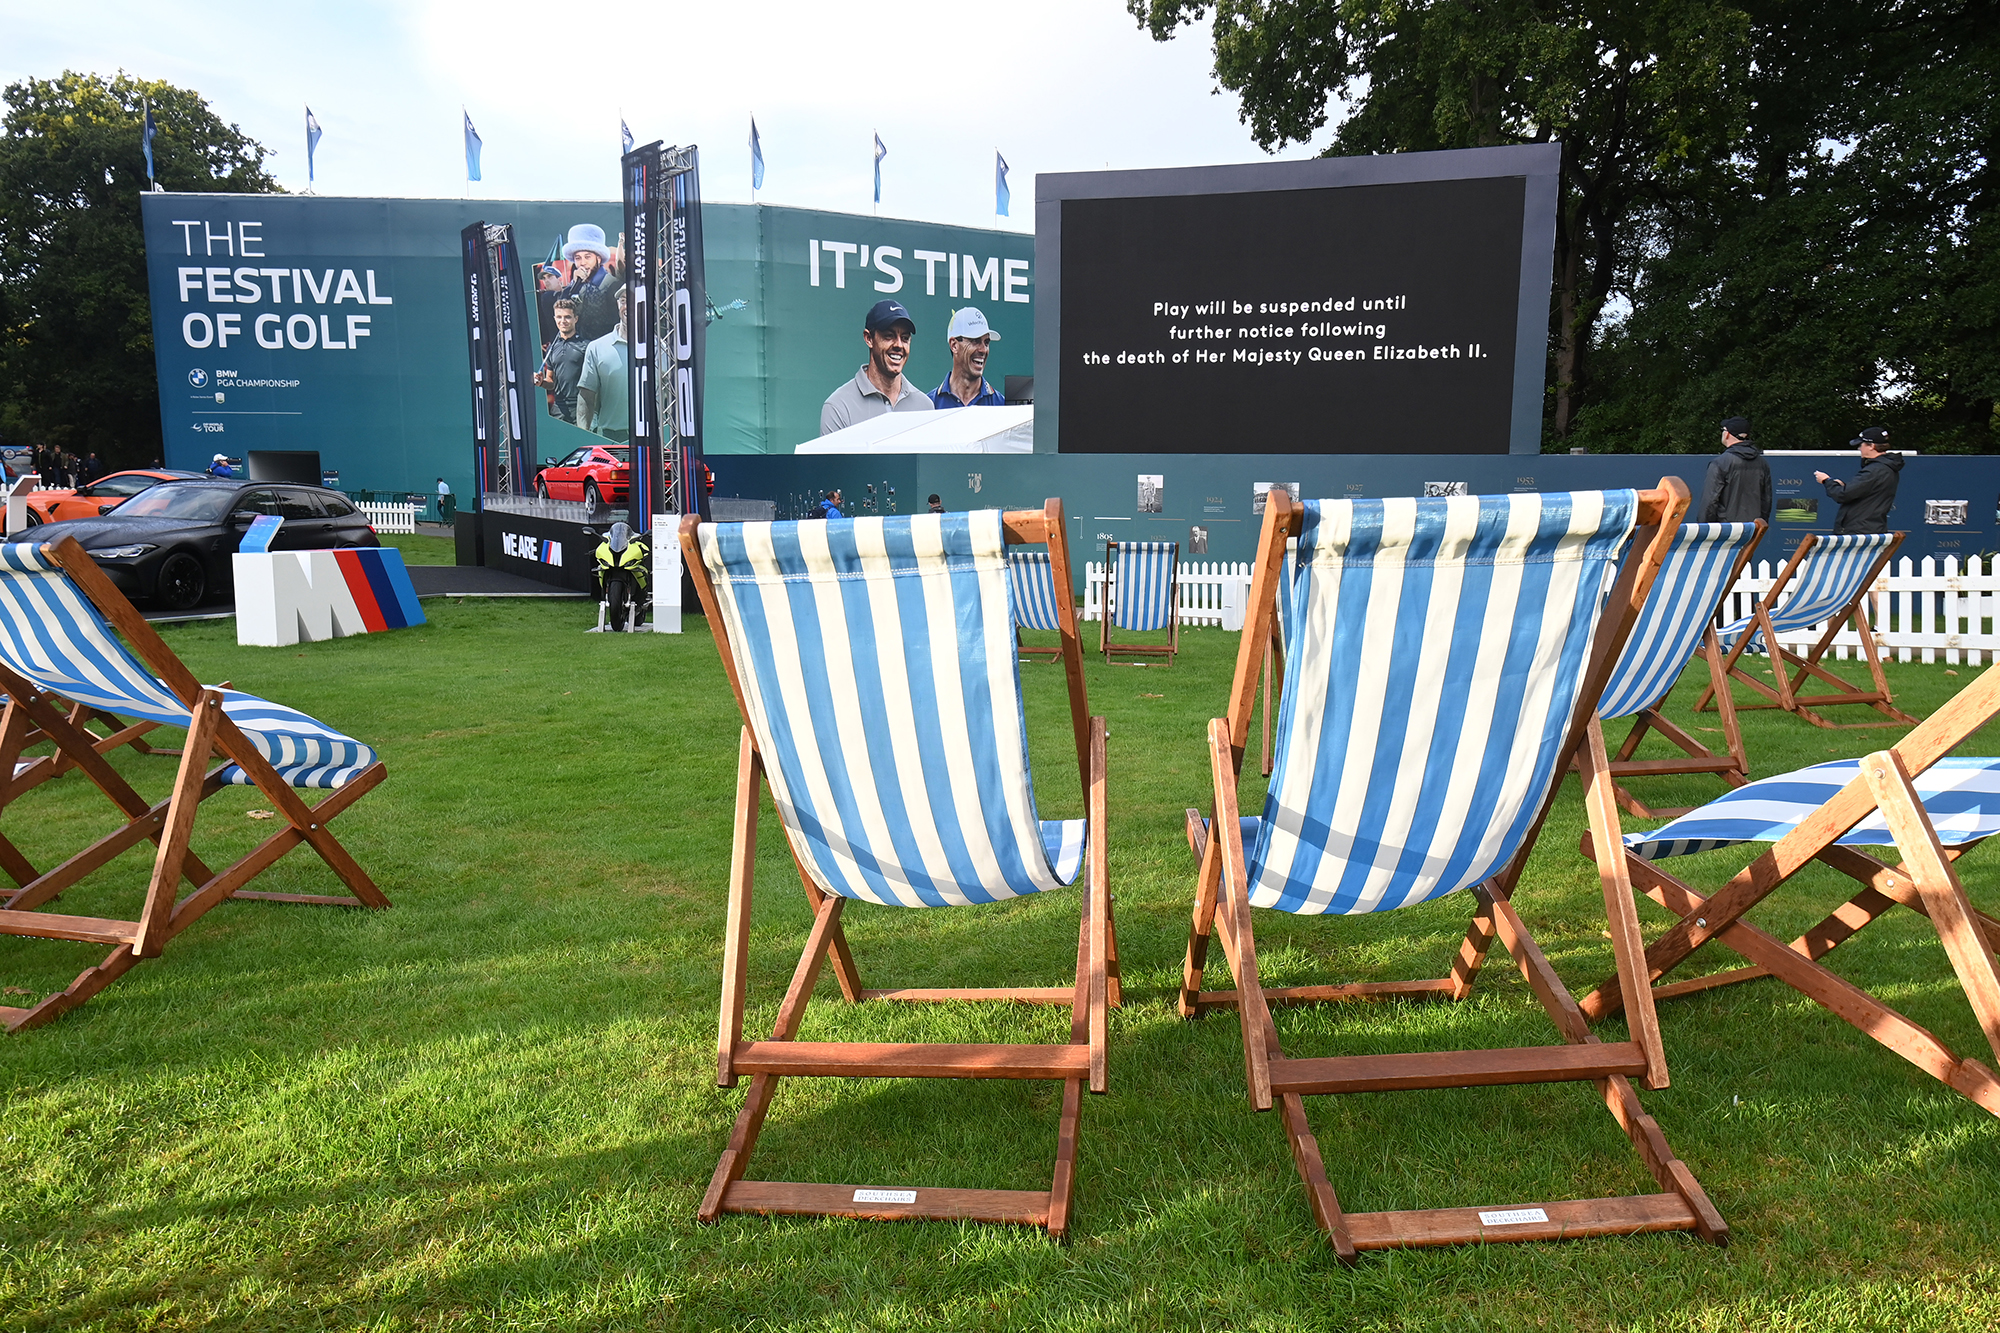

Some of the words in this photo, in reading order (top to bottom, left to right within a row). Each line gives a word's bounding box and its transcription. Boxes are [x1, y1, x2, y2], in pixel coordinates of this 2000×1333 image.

[172, 220, 266, 257] THE
[809, 239, 904, 294] IT'S
[913, 249, 1030, 303] TIME
[177, 266, 393, 305] FESTIVAL
[1153, 302, 1190, 319] Play
[1195, 300, 1226, 315] will
[1232, 299, 1253, 314] be
[1259, 297, 1355, 317] suspended
[1362, 295, 1406, 311] until
[182, 312, 242, 349] OF
[254, 313, 372, 350] GOLF
[1169, 325, 1232, 340] further
[1238, 324, 1294, 338] notice
[1300, 321, 1386, 339] following
[1083, 351, 1111, 365] the
[1116, 350, 1165, 364] death
[1171, 349, 1190, 363] of
[1196, 349, 1226, 363] Her
[1232, 348, 1302, 366] Majesty
[1308, 346, 1366, 362] Queen
[1373, 344, 1461, 360] Elizabeth
[216, 370, 238, 378] BMW
[217, 379, 235, 387] PGA
[236, 379, 300, 388] CHAMPIONSHIP
[1346, 483, 1364, 492] 1927
[1517, 476, 1535, 485] 1953
[1777, 478, 1803, 487] 2009
[1205, 496, 1223, 504] 1924
[1096, 532, 1113, 541] 1805
[1784, 537, 1801, 545] 201
[502, 531, 518, 558] WE
[518, 534, 538, 561] ARE
